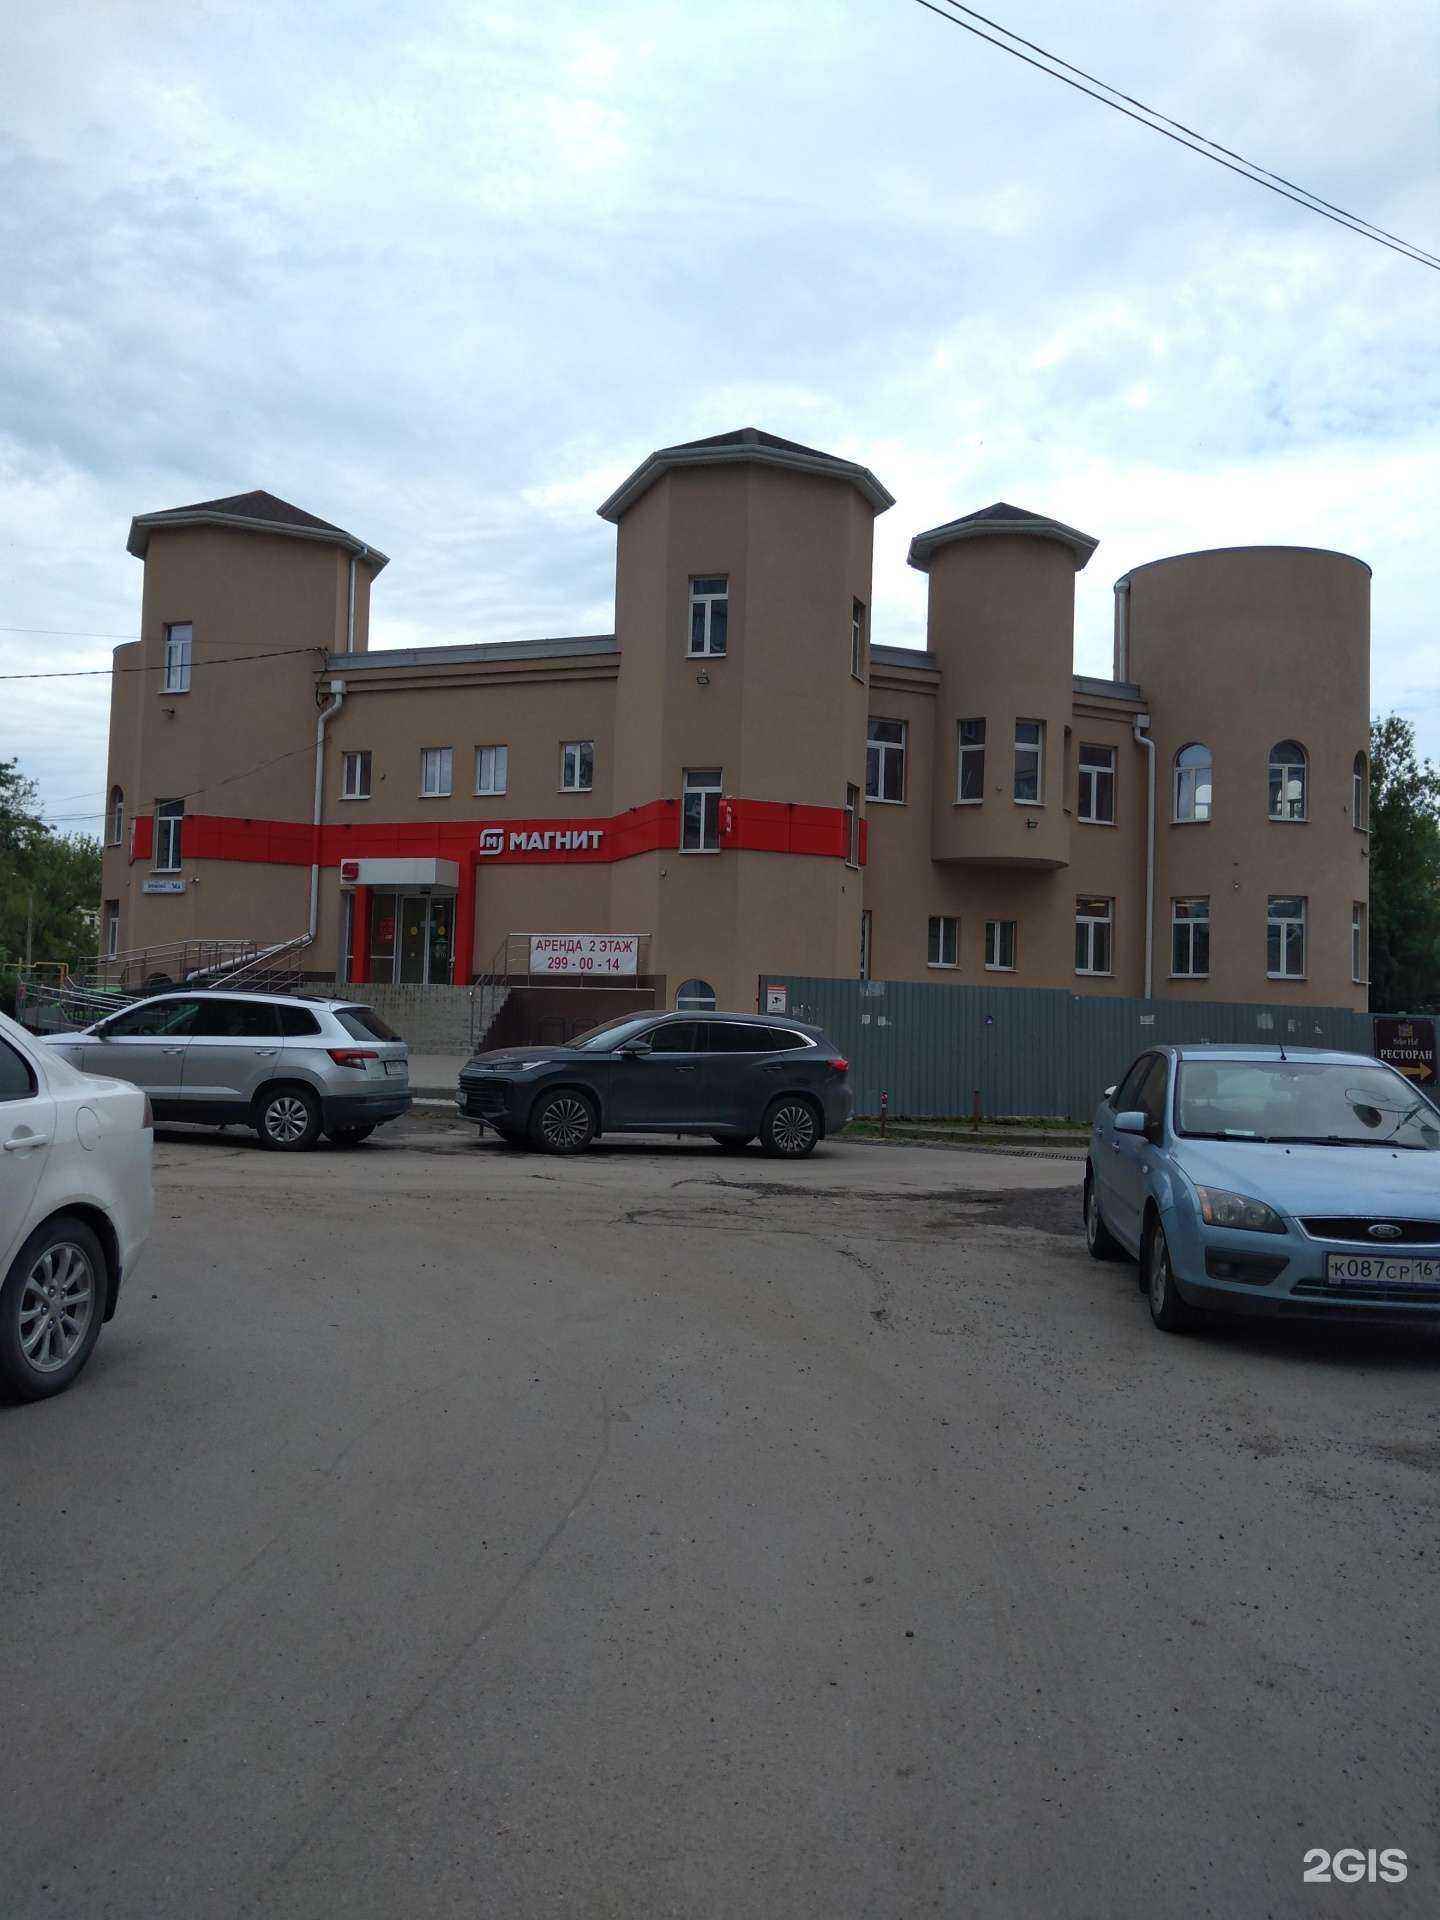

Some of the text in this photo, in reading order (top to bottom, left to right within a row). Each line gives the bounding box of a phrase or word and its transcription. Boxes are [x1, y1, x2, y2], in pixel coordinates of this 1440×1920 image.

[509, 830, 603, 850] МАГНИТ
[535, 940, 633, 953] АРЕНДА 2 ЭТАЖ
[1380, 1049, 1433, 1060] РЕСТОРАН
